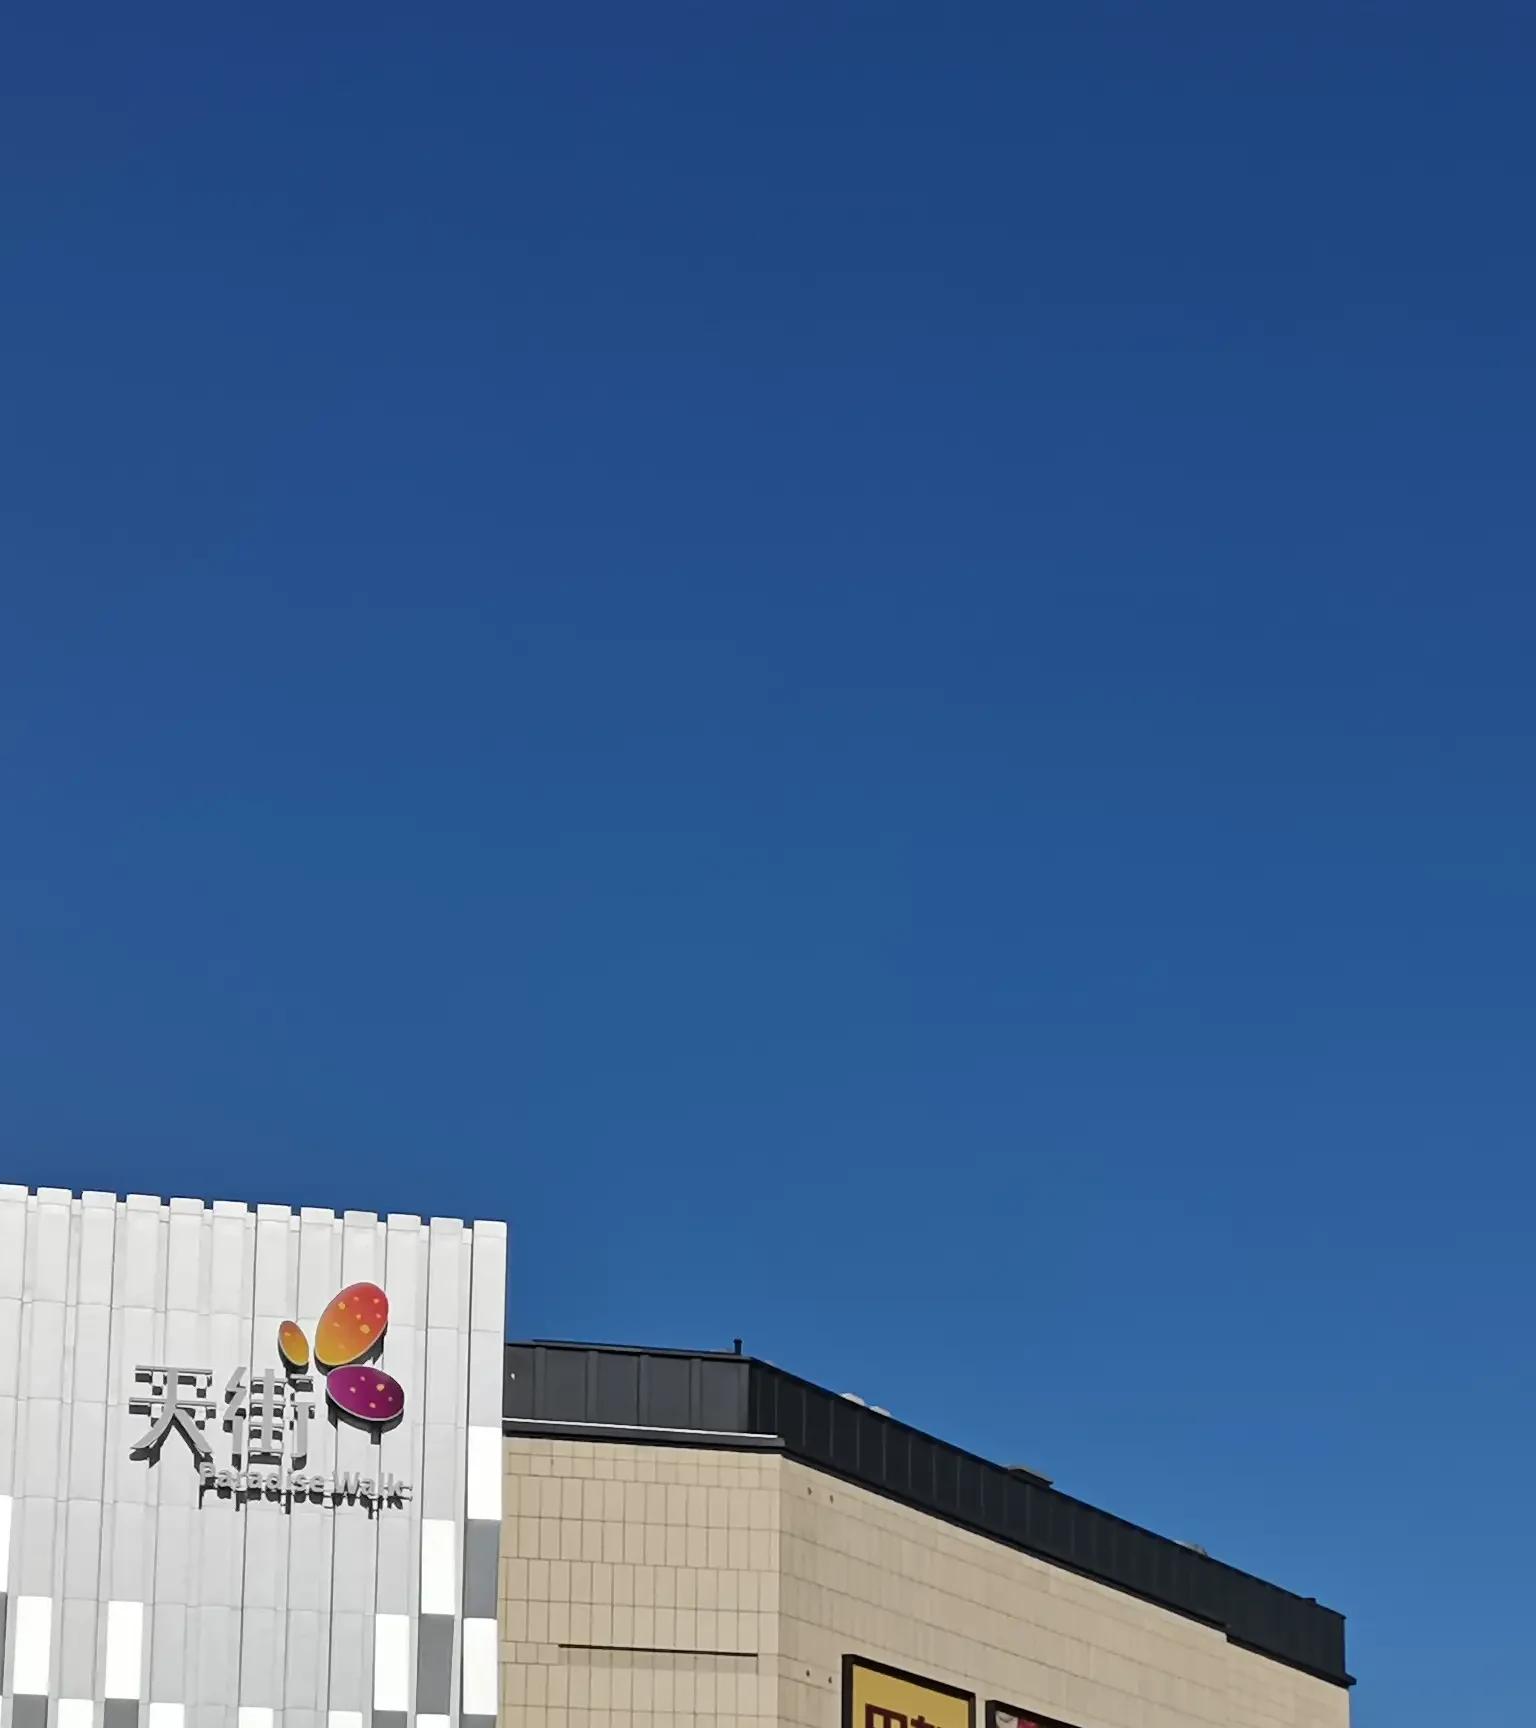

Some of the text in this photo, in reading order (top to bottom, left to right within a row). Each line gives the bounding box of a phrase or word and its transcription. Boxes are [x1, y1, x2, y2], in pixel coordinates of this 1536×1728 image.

[129, 1365, 316, 1457] 天街
[199, 1461, 404, 1498] Paradise Walk
